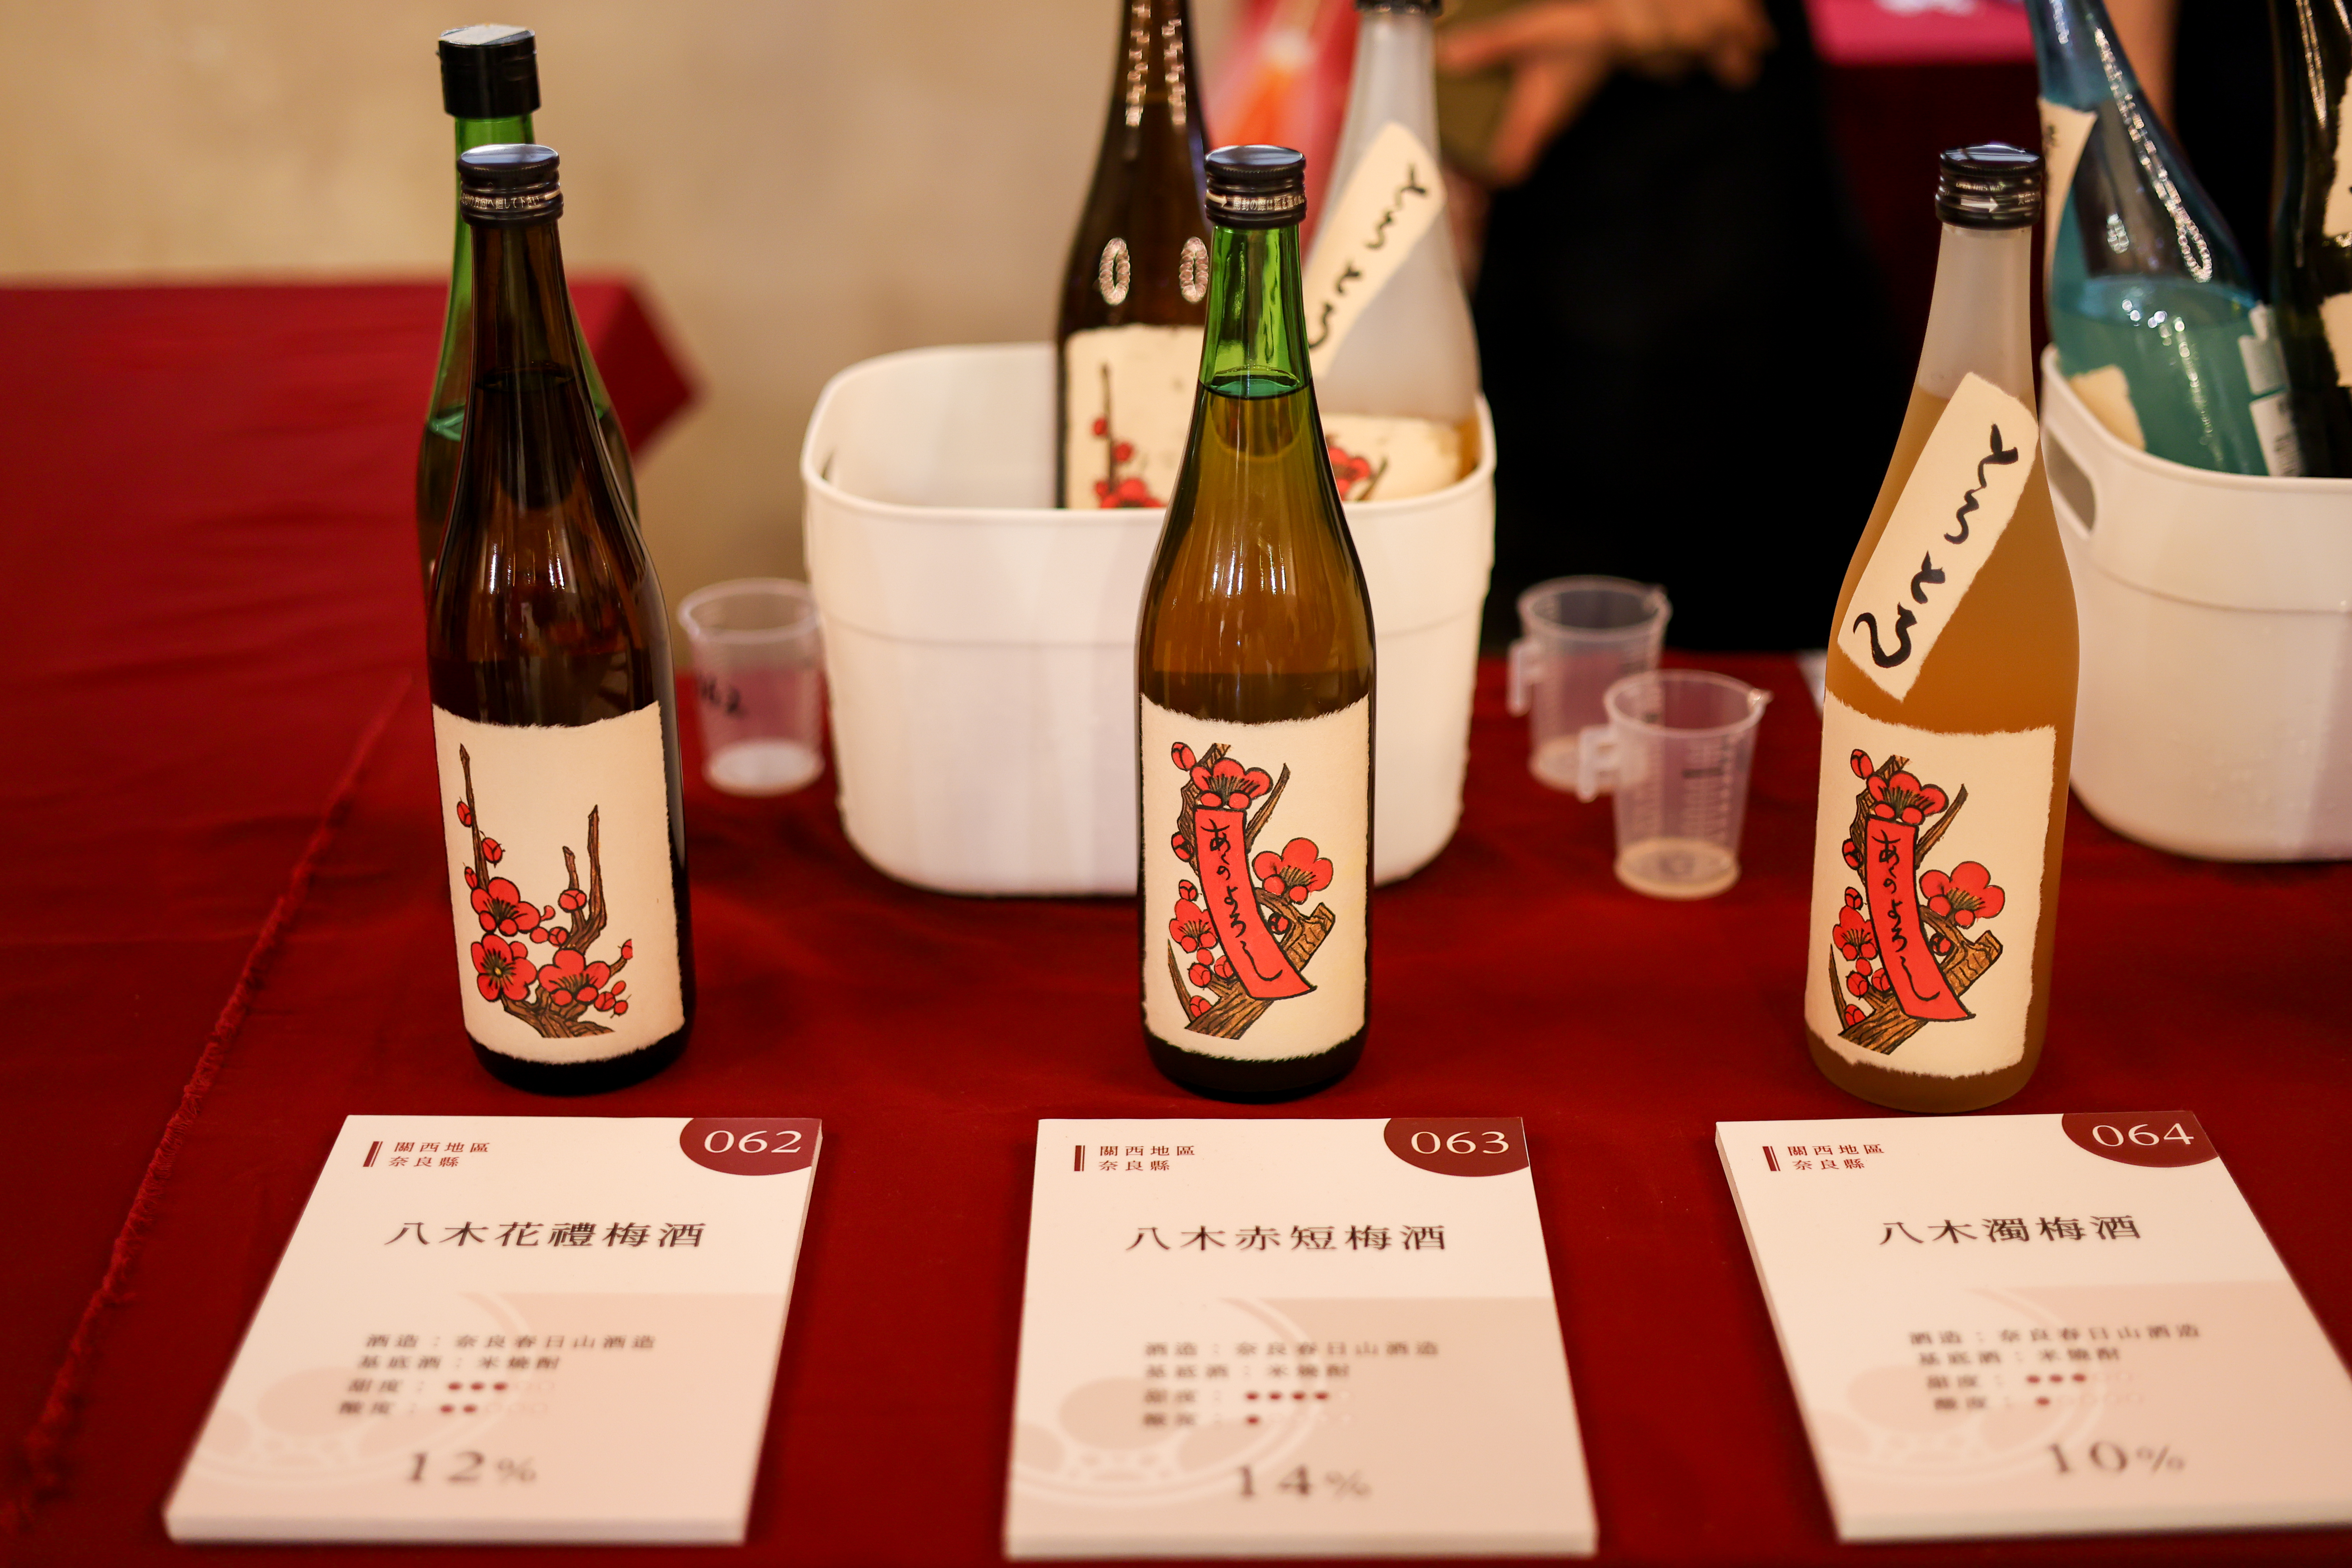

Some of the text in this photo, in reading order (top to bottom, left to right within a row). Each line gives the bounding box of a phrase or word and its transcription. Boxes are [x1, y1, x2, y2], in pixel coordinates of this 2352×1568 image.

[704, 1130, 802, 1153] 062
[1410, 1131, 1509, 1155] 063
[2092, 1122, 2194, 1147] 064
[394, 1141, 490, 1153] 關西地區
[1099, 1145, 1195, 1157] 關西地區
[1787, 1143, 1884, 1157] 關西地區
[390, 1155, 459, 1168] 奈良縣
[1099, 1160, 1170, 1172] 奈良縣
[1794, 1158, 1865, 1171] 奈良縣
[386, 1221, 706, 1248] 八木花禮梅酒
[1128, 1225, 1445, 1251] 八木赤短梅酒
[1880, 1214, 2141, 1245] 八木濁梅酒
[408, 1451, 536, 1484] 12%
[2048, 1441, 2186, 1475] 10%
[1239, 1464, 1372, 1499] 14%
